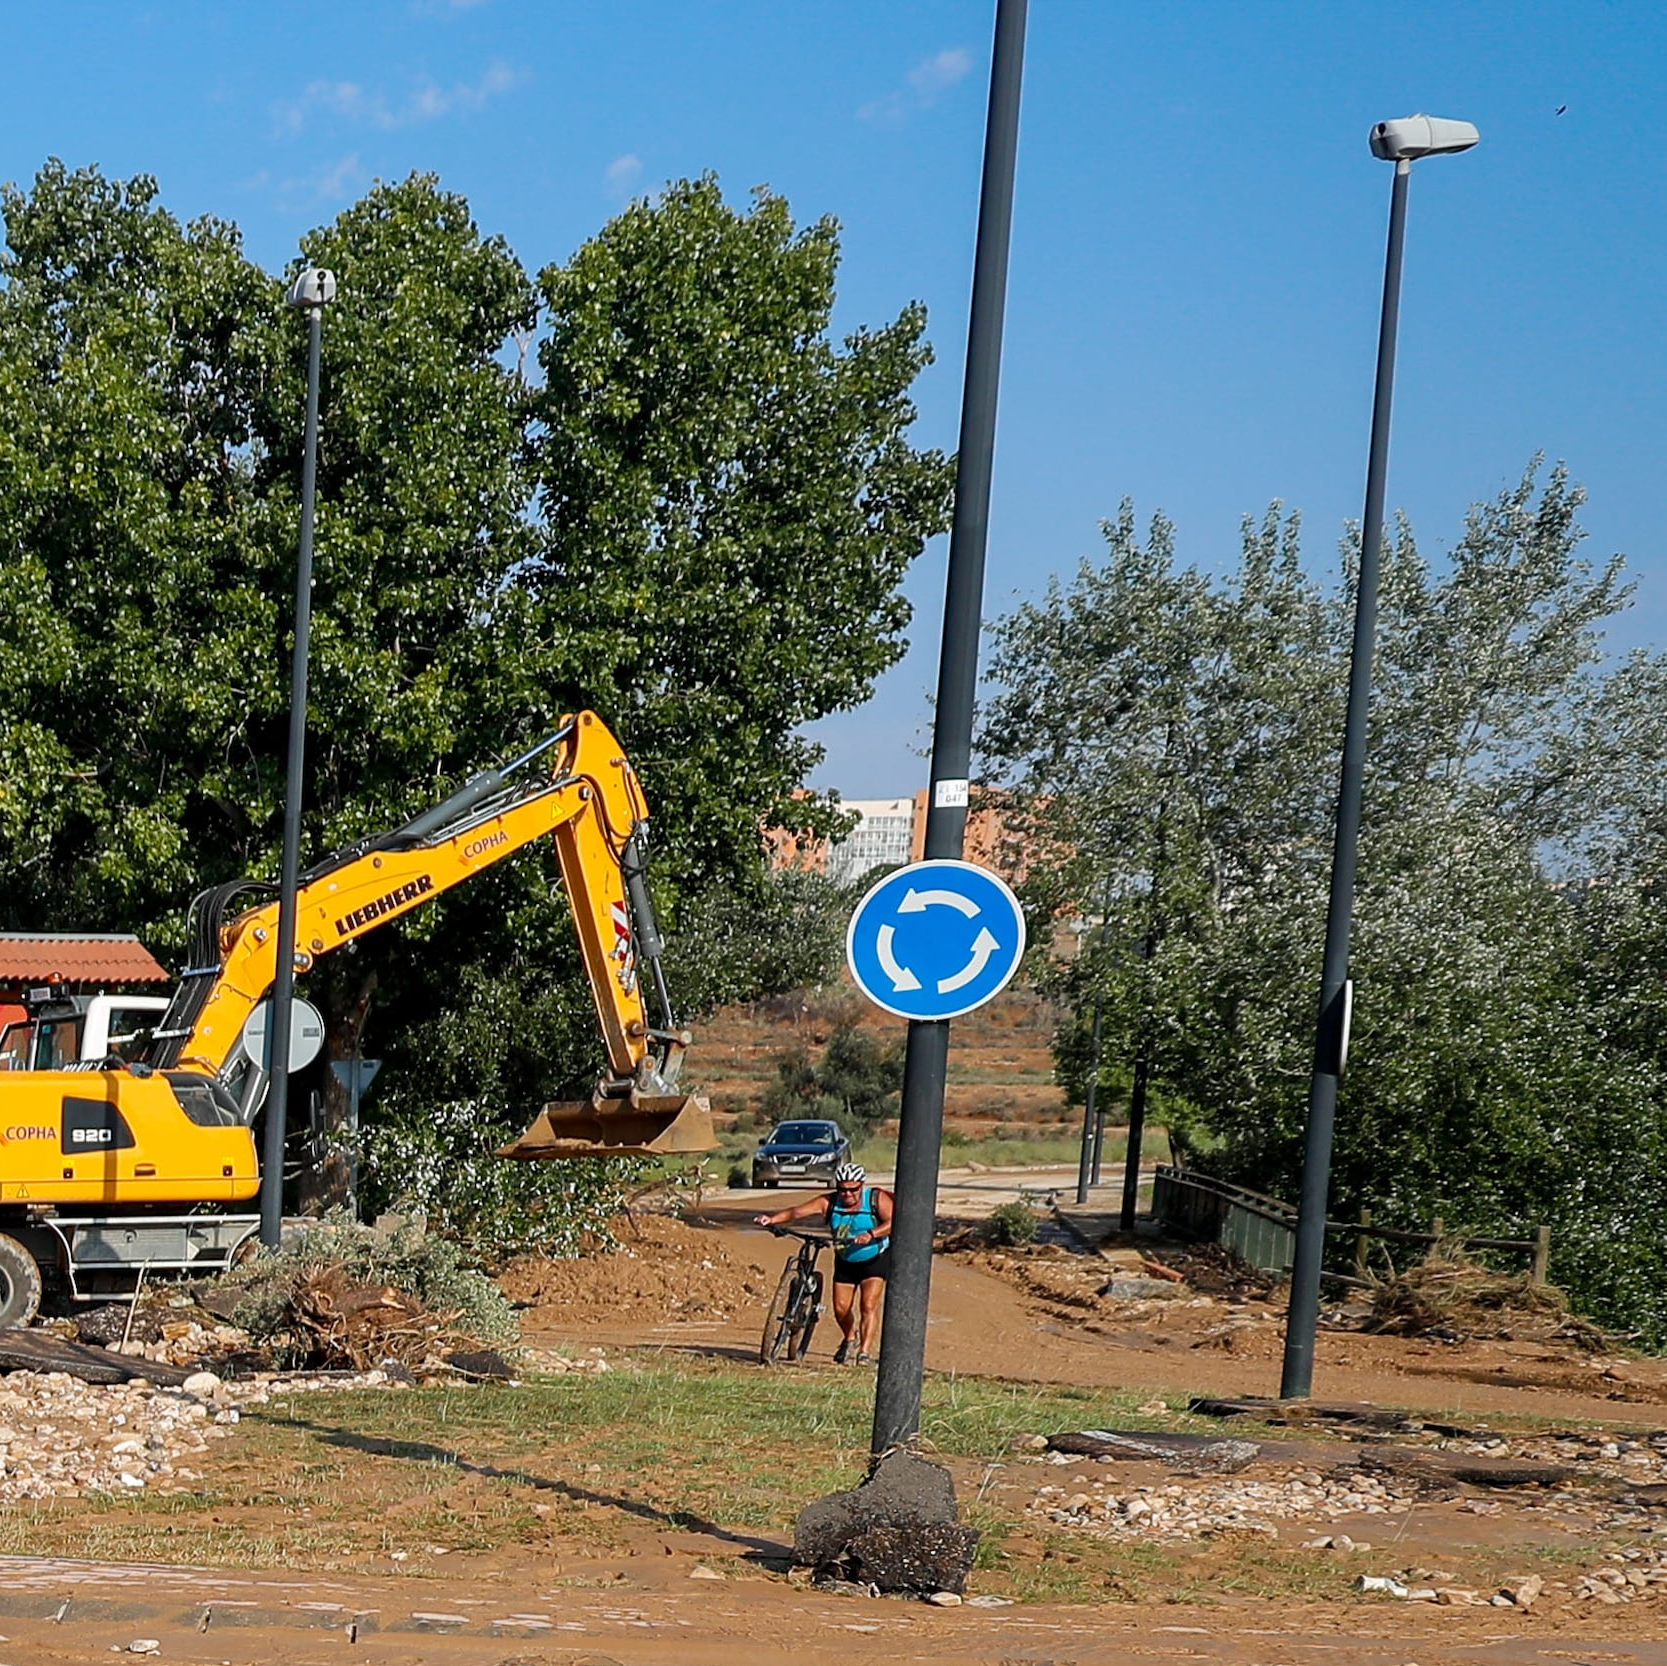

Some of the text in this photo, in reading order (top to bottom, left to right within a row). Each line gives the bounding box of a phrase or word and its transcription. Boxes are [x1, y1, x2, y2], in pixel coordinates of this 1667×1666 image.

[464, 831, 509, 859] COPHA
[334, 873, 435, 937] LIEBHERR
[6, 1126, 57, 1140] COPHA
[72, 1128, 112, 1142] 920
